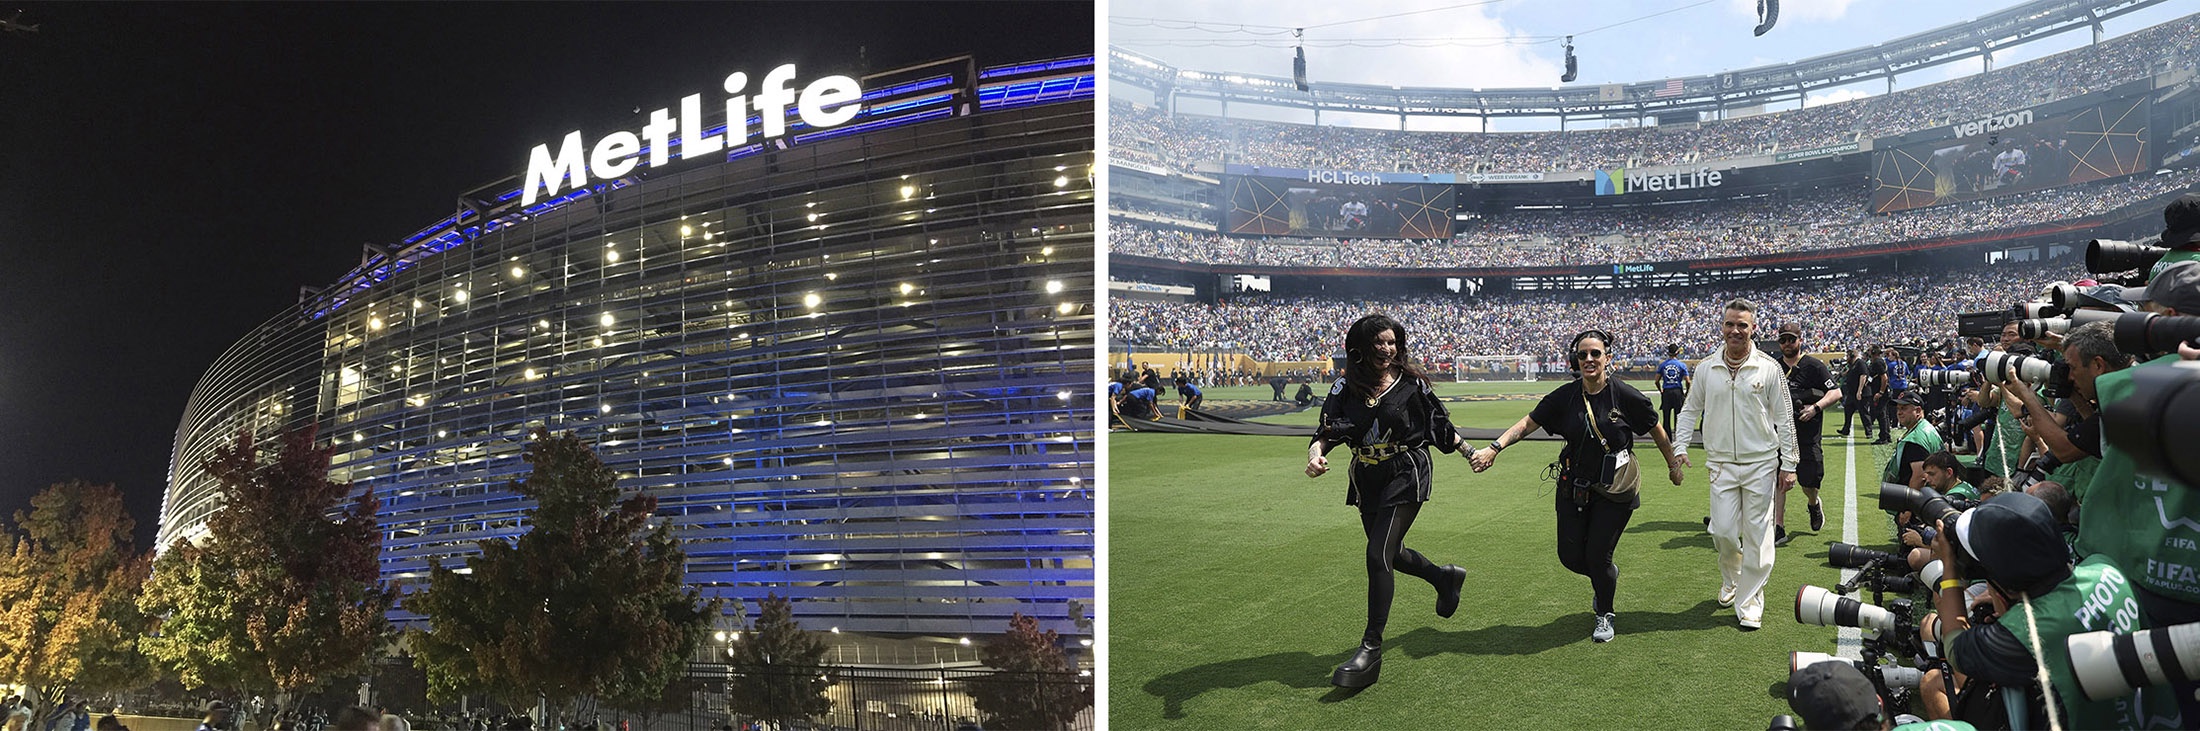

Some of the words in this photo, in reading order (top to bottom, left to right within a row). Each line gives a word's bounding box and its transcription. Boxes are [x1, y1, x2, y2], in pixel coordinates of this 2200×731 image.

[1953, 109, 2033, 139] verizon
[520, 63, 863, 207] MetLife
[1788, 151, 1805, 159] SUPER
[1805, 149, 1821, 157] BOWL
[1827, 143, 1858, 153] CHAMPIONS
[1308, 170, 1381, 186] HCLTech
[1628, 166, 1722, 193] MetLife
[1625, 264, 1654, 273] MetLife
[2165, 537, 2197, 551] FIFA
[2075, 567, 2125, 631] PHOTO
